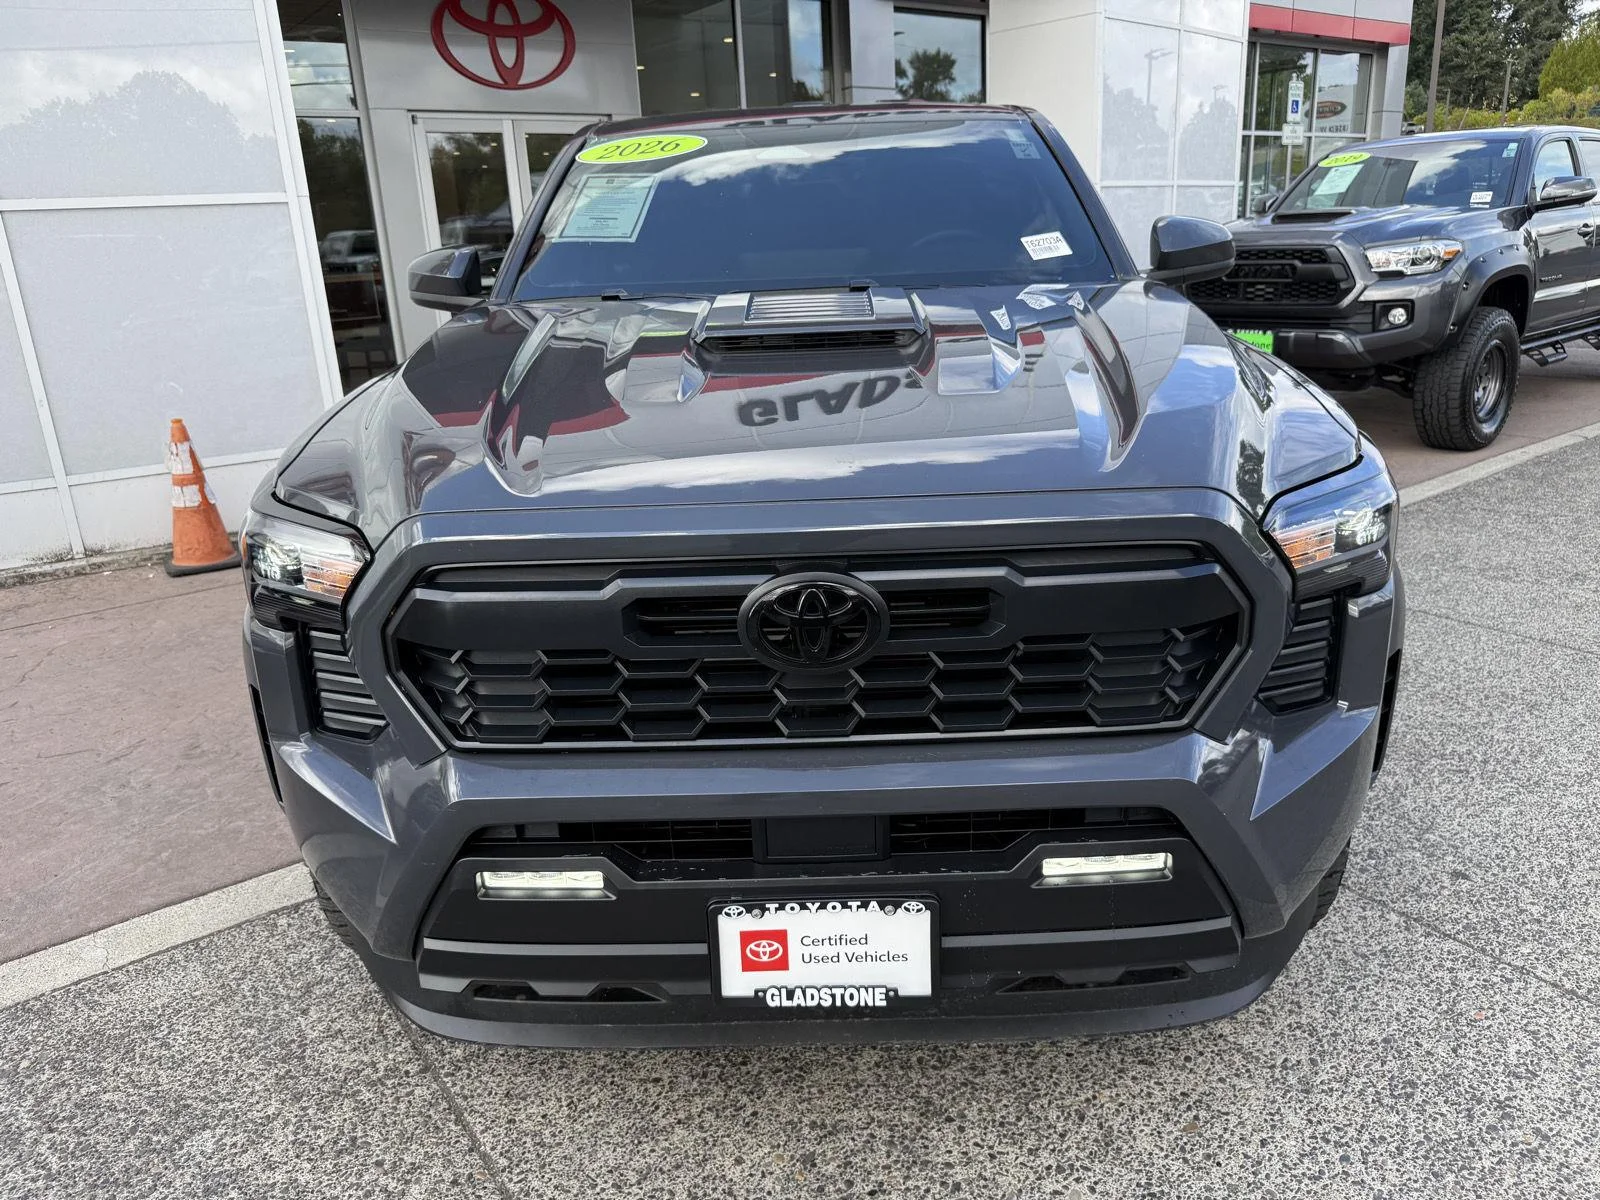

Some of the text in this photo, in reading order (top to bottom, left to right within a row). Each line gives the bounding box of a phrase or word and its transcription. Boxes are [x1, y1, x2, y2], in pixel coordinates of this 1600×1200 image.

[596, 138, 687, 160] 2026
[1025, 236, 1064, 248] T62703A
[765, 901, 883, 914] TOYOTA
[800, 934, 869, 947] Certified
[801, 951, 908, 964] Used Vehicles
[765, 987, 887, 1007] GLADSTONE
